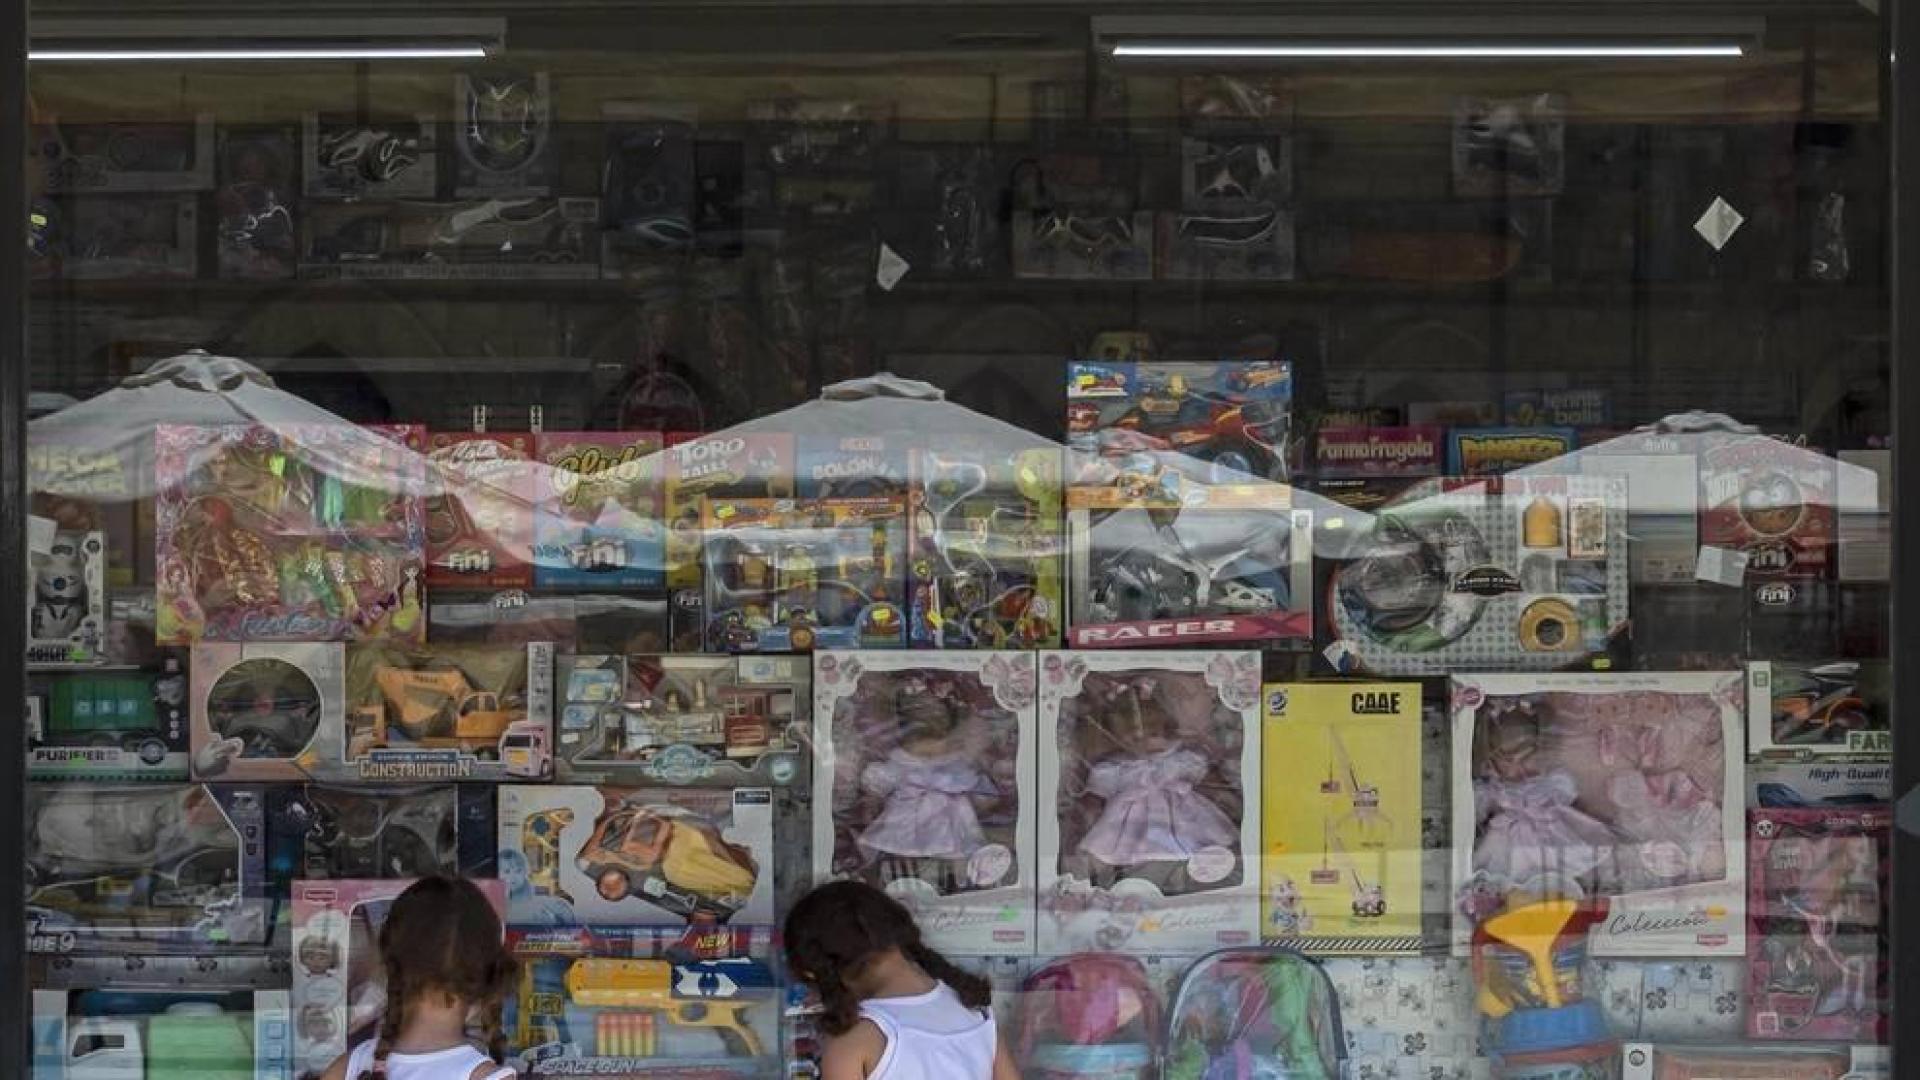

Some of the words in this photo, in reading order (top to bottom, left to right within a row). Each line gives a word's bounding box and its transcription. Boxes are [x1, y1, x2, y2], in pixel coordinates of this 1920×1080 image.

[673, 437, 746, 465] TORO
[1078, 619, 1235, 645] RACER
[696, 934, 730, 949] NEW
